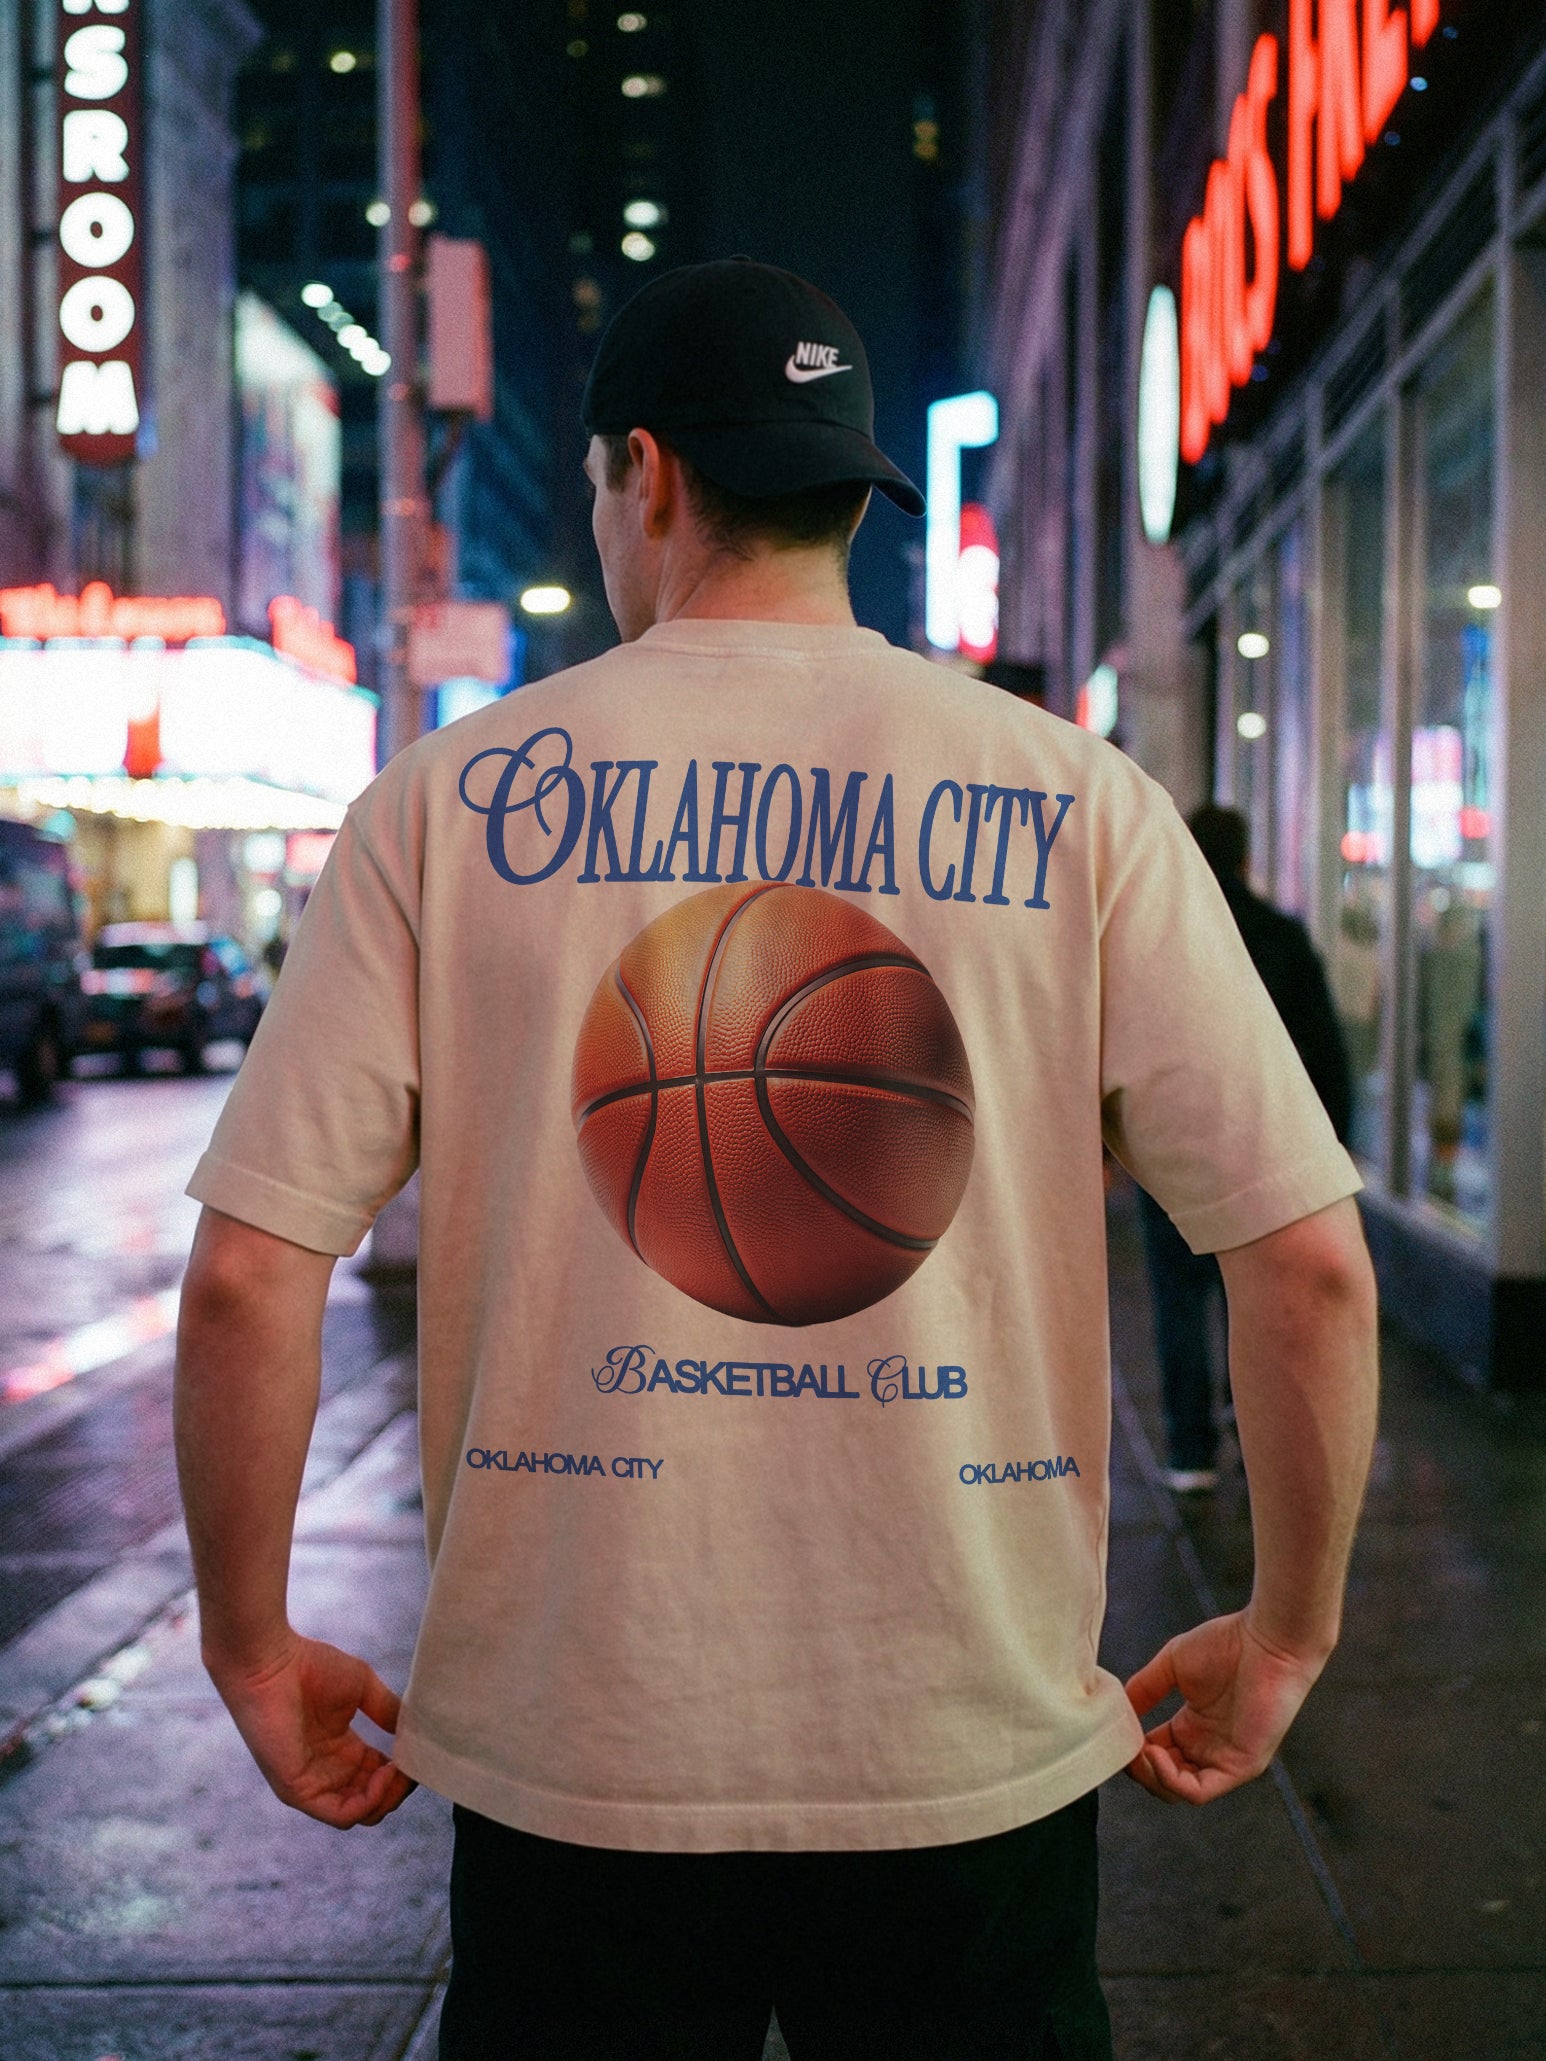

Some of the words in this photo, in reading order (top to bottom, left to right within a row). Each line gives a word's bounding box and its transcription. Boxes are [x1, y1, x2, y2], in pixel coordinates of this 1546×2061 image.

[57, 0, 139, 435] SROOM
[796, 341, 839, 368] NIKE
[458, 727, 900, 895] OKLAHOMA
[918, 779, 1075, 909] CITY
[591, 1345, 860, 1399] BASKETBALL
[868, 1355, 968, 1408] CLUB
[466, 1448, 606, 1477] OKLAHOMA
[611, 1457, 664, 1480] CITY
[959, 1456, 1080, 1485] OKLAHOMA
